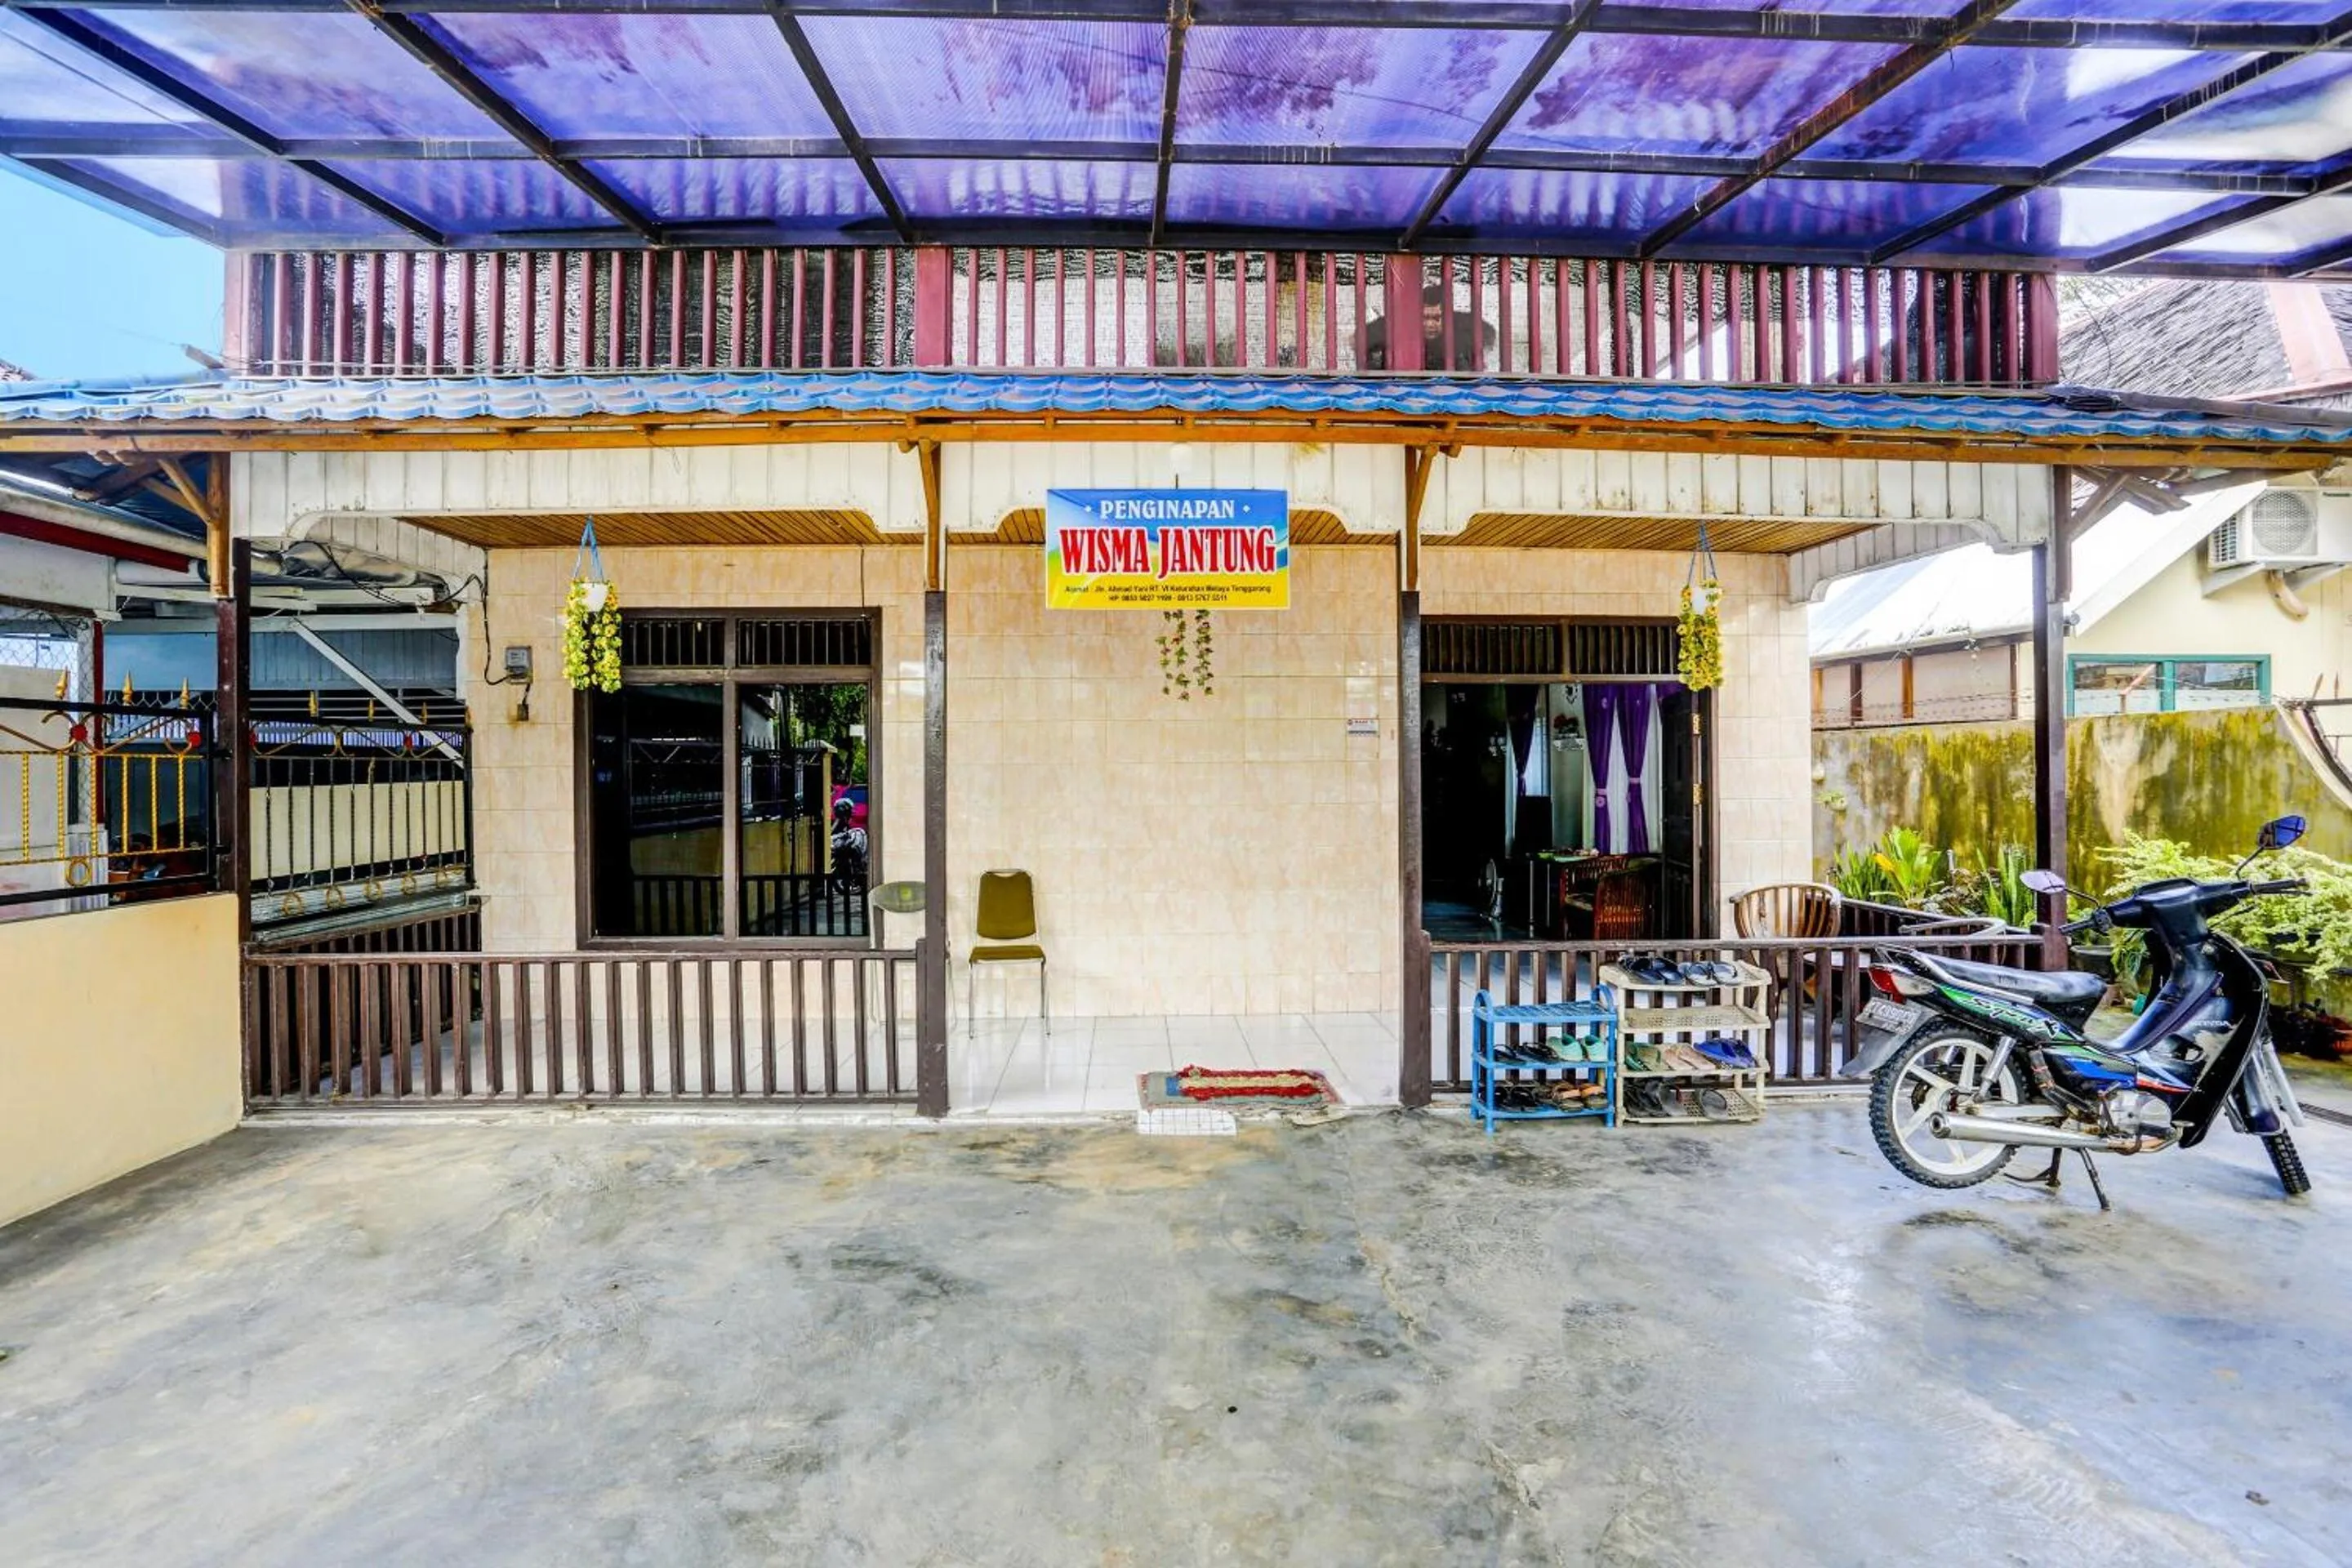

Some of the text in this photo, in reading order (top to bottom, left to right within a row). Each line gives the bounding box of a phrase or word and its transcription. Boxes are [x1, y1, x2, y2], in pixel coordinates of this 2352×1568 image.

[1100, 499, 1235, 519] PENGINAPAN
[1058, 527, 1277, 580] WISMA JANTUNG
